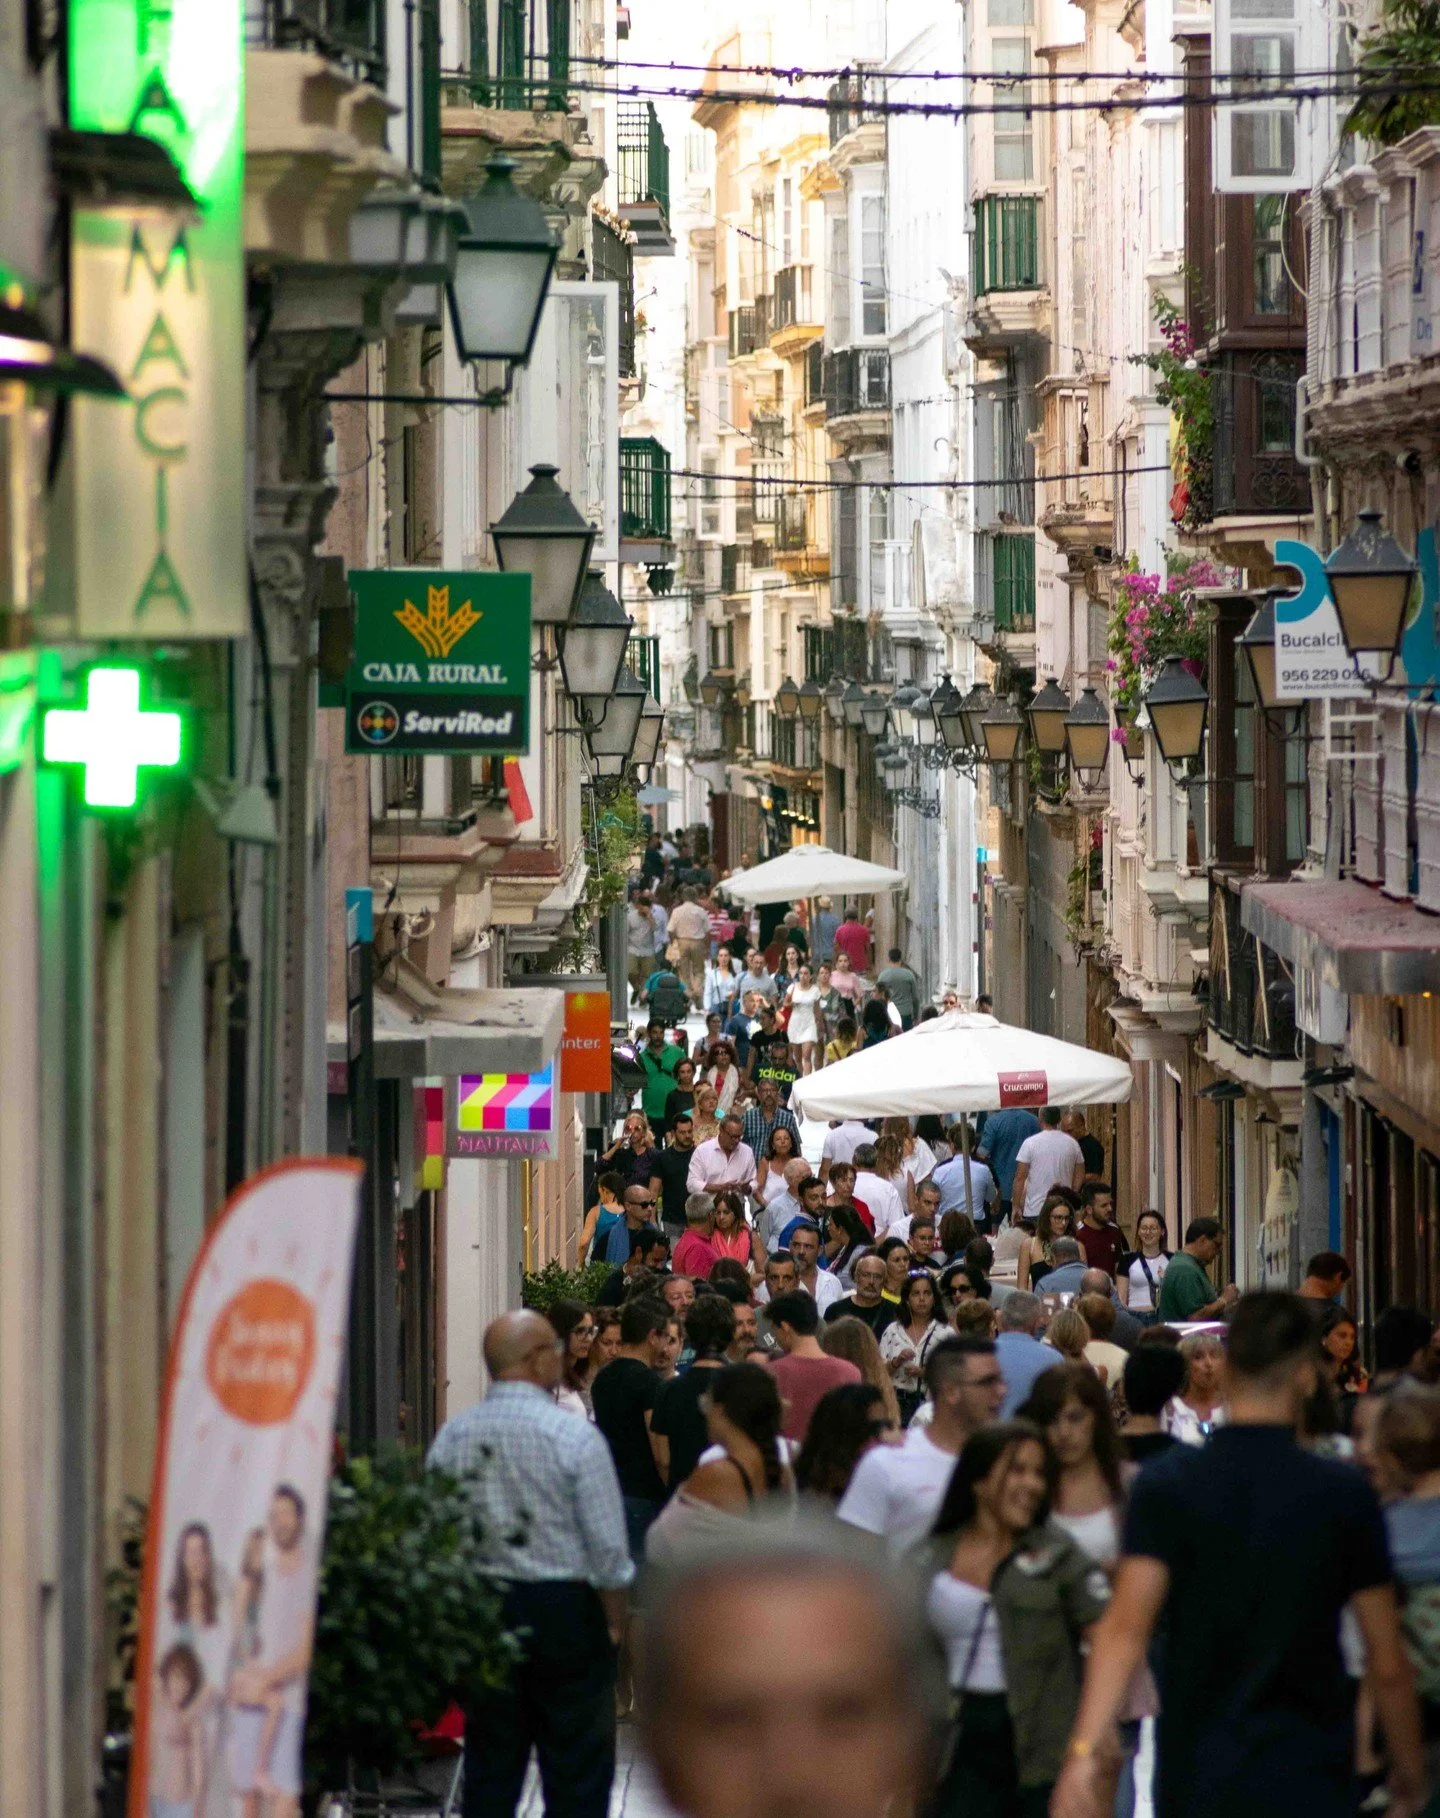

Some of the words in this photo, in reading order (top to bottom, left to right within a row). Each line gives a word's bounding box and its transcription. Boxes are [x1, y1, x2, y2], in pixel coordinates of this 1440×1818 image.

[124, 0, 196, 623] FAMACIA
[1281, 632, 1342, 648] Bucalcl
[363, 663, 421, 683] CAJA
[428, 664, 508, 684] RURAL
[1282, 669, 1309, 682] 956
[1312, 668, 1339, 681] 229
[1282, 682, 1364, 690] www.bucalclinic.co
[404, 711, 513, 734] ServiRed
[562, 1036, 601, 1049] inter.
[1003, 1083, 1044, 1092] Cruzcampo
